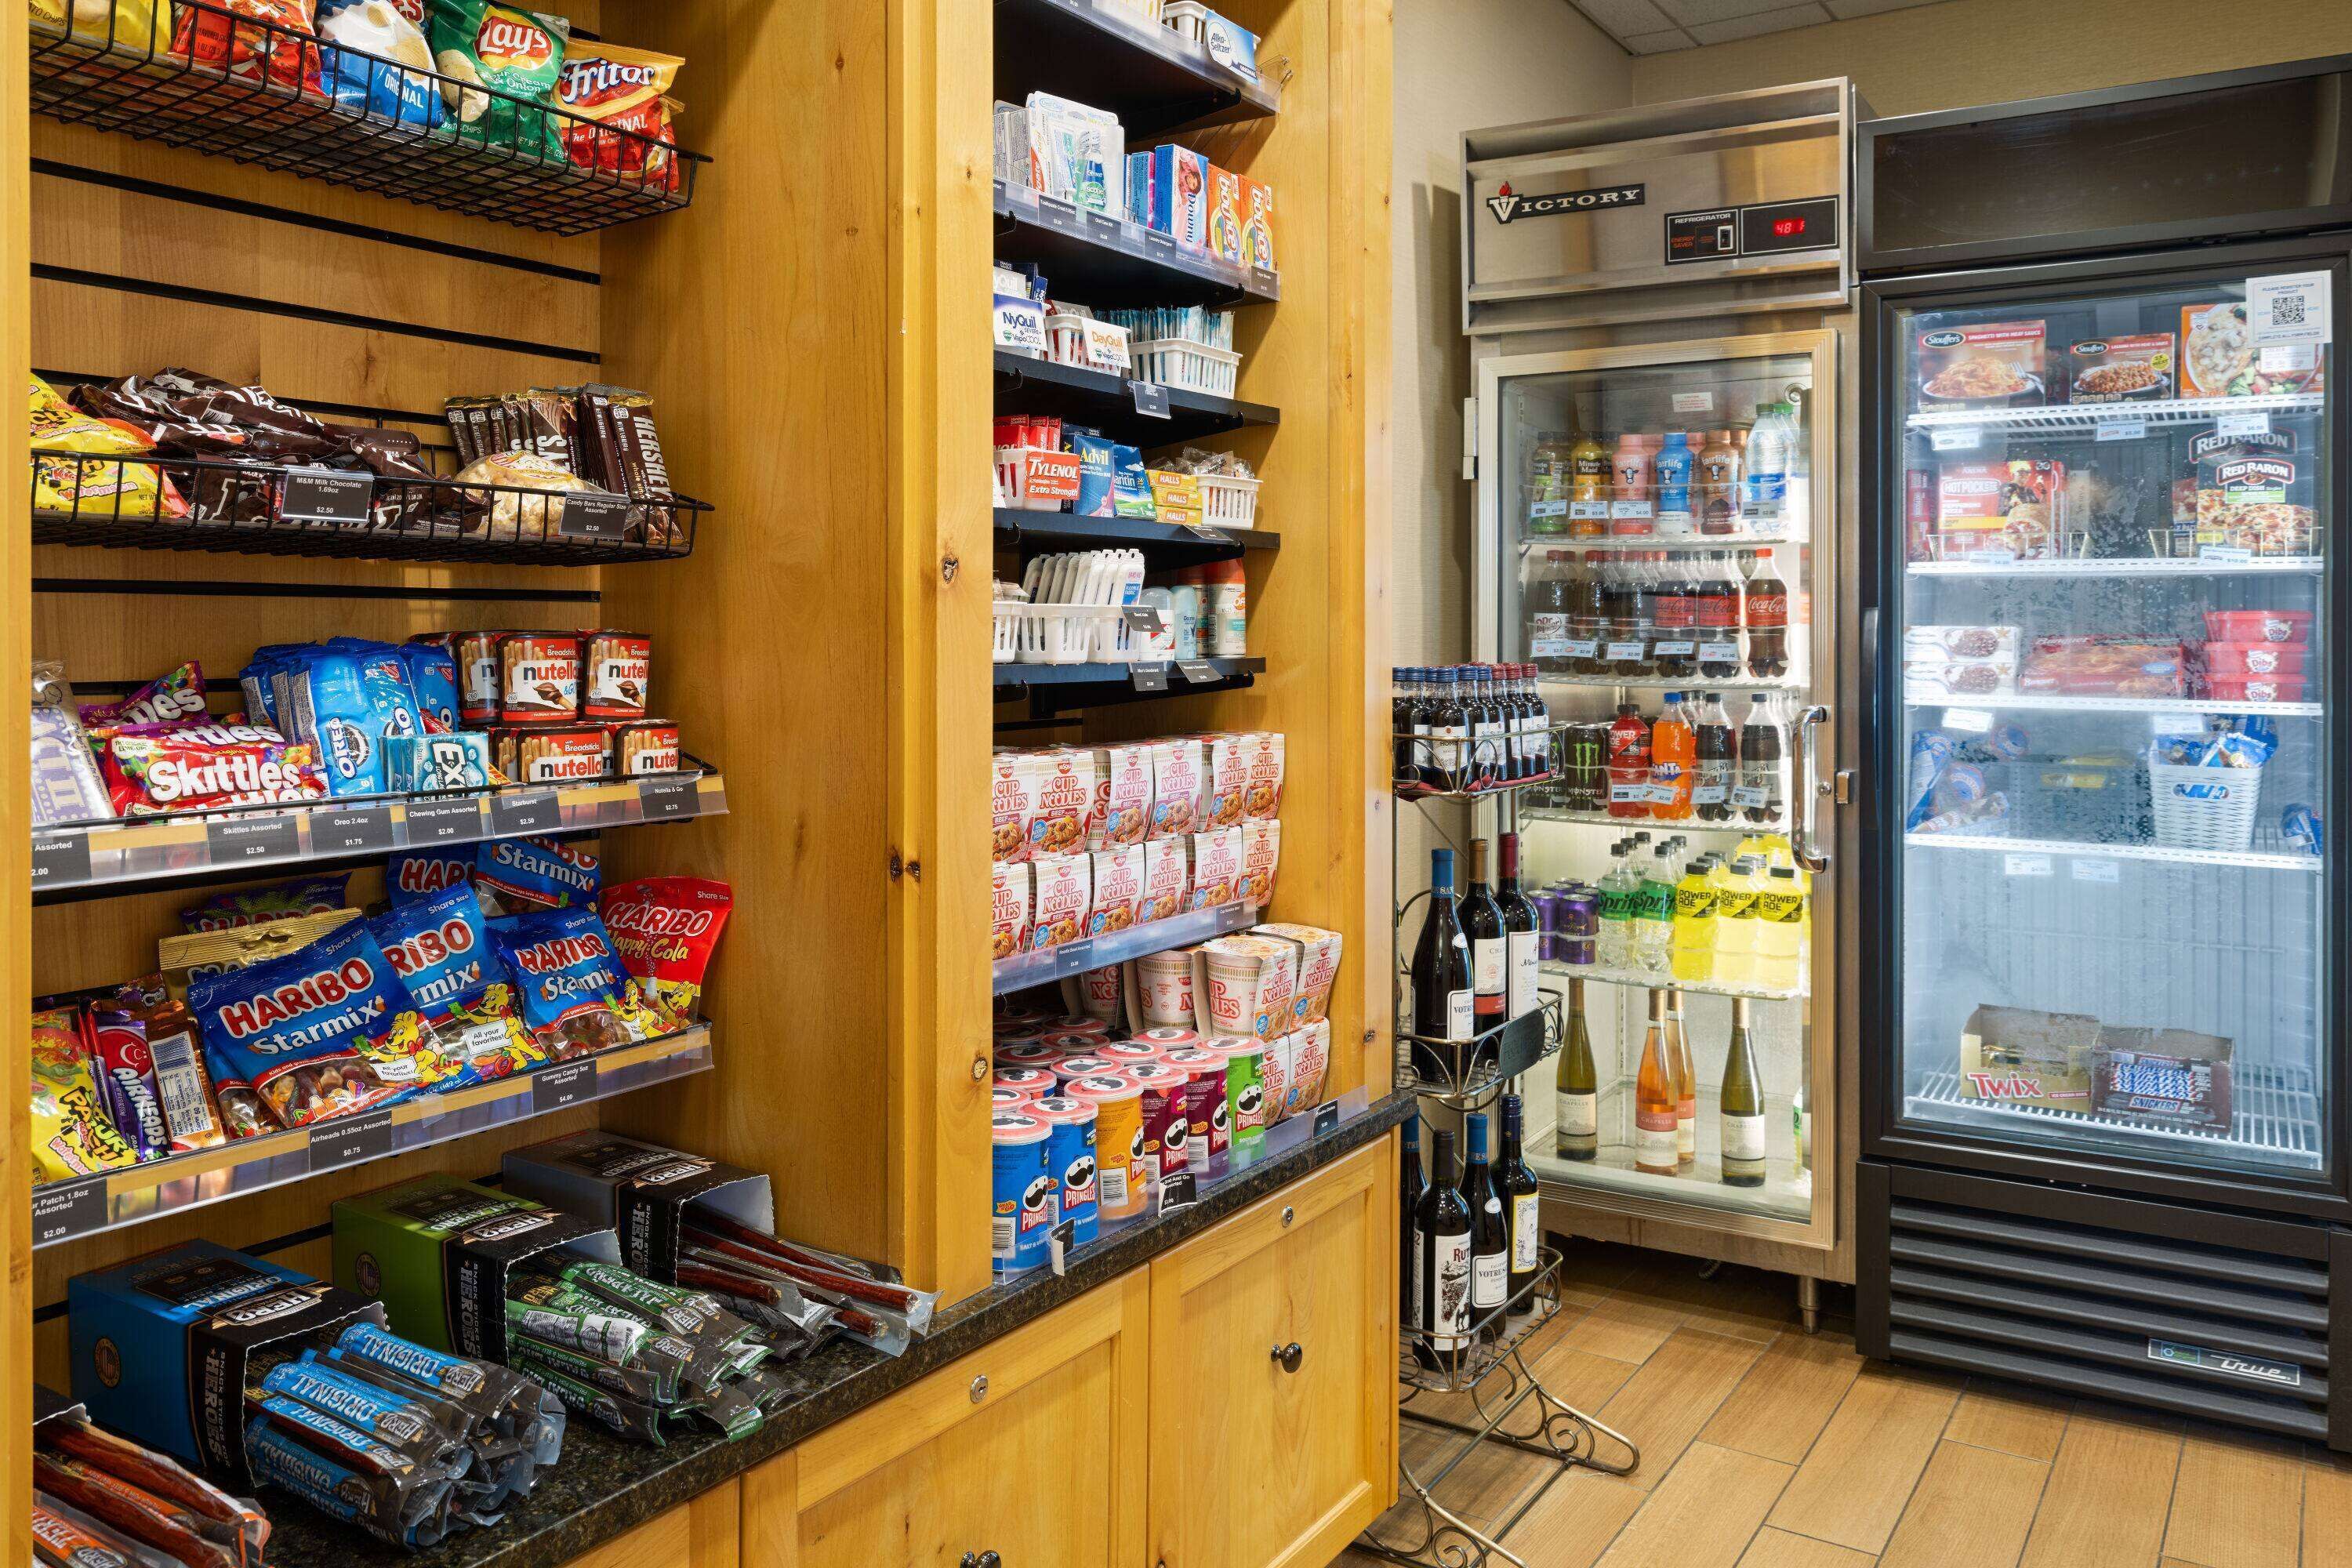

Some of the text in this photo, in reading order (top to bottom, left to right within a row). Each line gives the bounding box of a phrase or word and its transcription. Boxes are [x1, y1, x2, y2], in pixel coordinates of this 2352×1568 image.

[1210, 32, 1227, 43] Alka-
[1210, 41, 1230, 54] Seltzer
[558, 57, 655, 104] Fritos
[1217, 173, 1238, 252] bounce
[1488, 187, 1641, 223] VICTORY
[1185, 193, 1196, 243] Downy
[1250, 184, 1269, 263] bounce
[1674, 212, 1732, 225] REFRIGERATOR
[1002, 311, 1036, 329] NyQuil
[1091, 330, 1123, 348] DayQuil
[2196, 436, 2226, 455] RED
[1079, 446, 1109, 466] Advil
[1029, 458, 1078, 480] TYLENOL
[2222, 462, 2288, 479] RED BARON
[296, 476, 313, 485] M&M
[329, 479, 362, 489] Chocolate
[1160, 476, 1180, 485] HALLS
[318, 486, 339, 495] 1.69oz
[1029, 486, 1078, 497] Extra Strength
[1167, 494, 1187, 503] HALLS
[1166, 511, 1186, 521] HALLS
[2268, 627, 2288, 637] Dibs
[2252, 658, 2273, 668] Dibs
[2251, 690, 2271, 699] Dibs
[1169, 761, 1189, 778] CUP
[1225, 757, 1242, 771] CUP
[149, 754, 300, 803] Skittles
[1124, 768, 1142, 784] CUP
[1051, 775, 1078, 793] CUP
[511, 798, 537, 808] Starburst
[1040, 788, 1087, 809] NOODLES
[409, 806, 477, 818] Chewing Gum Assorted
[334, 816, 368, 826] Oreo 2.4oz
[520, 817, 535, 826] $2.50
[223, 822, 282, 836] Skittles Assorted
[438, 827, 454, 836] $2.00
[34, 841, 72, 851] Assorted
[246, 845, 265, 855] $2.50
[345, 838, 362, 847] $1.75
[1210, 848, 1230, 863] CUP
[495, 842, 596, 891] Starmix
[1109, 868, 1131, 884] CUP
[1053, 878, 1076, 896] CUP
[1679, 889, 1711, 900] POWER
[698, 891, 717, 899] Share
[1679, 897, 1696, 907] ADE
[1763, 892, 1798, 905] POWER
[427, 897, 456, 915] Share
[1763, 901, 1782, 911] ADE
[565, 915, 586, 929] Share
[604, 902, 713, 936] HARIBO
[325, 935, 350, 956] Share
[517, 932, 610, 975] HARIBO
[1272, 969, 1289, 989] CUP
[217, 956, 376, 1040] HARIBO
[250, 997, 384, 1056] Starmix
[485, 1029, 499, 1038] your
[471, 1034, 505, 1047] favorites!
[1301, 1044, 1319, 1062] CUP
[541, 1065, 589, 1082] Gummy Candy 5oz
[554, 1074, 578, 1085] Assorted
[1967, 1071, 2044, 1099] Twix
[559, 1094, 573, 1102] $4.00
[2131, 1098, 2180, 1111] SNICKERS
[112, 1066, 169, 1146] AIRHEADS
[310, 1119, 391, 1144] Airheads 0.55oz Assorted
[343, 1147, 361, 1157] $0.75
[41, 1189, 89, 1207] Patch 1.8oz
[34, 1200, 74, 1216] Assorted
[43, 1226, 67, 1239] $2.00
[234, 1290, 314, 1323] HERO
[361, 1334, 440, 1378] ORIGINAL
[291, 1374, 379, 1424] ORIGINAL
